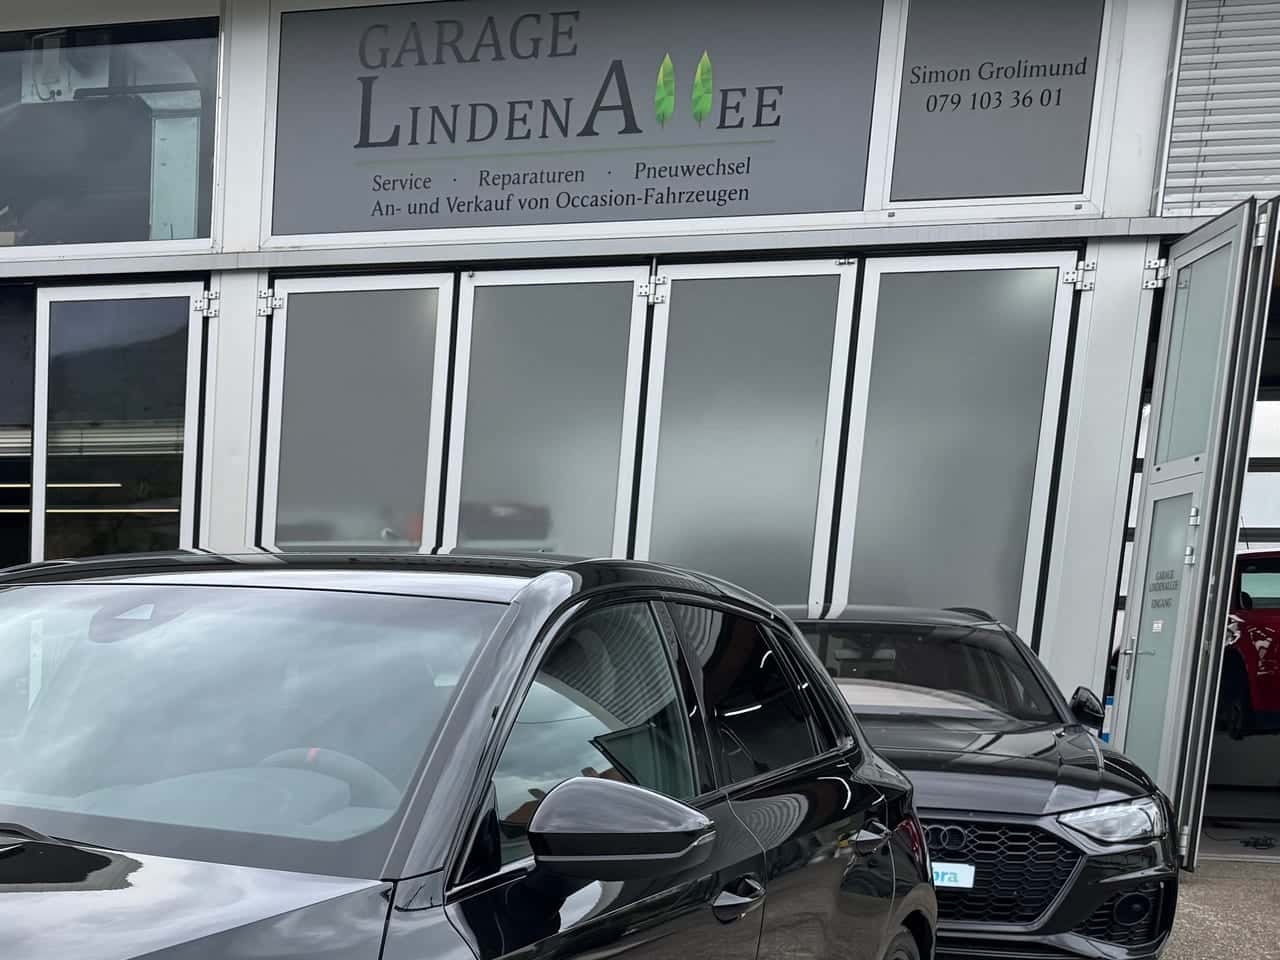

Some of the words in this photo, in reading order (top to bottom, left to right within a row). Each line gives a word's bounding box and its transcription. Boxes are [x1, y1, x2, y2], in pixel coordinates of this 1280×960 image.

[358, 10, 581, 70] GARAGE
[910, 65, 970, 84] Simon
[978, 56, 1087, 81] Grolimund
[926, 93, 961, 112] 079
[970, 91, 1002, 110] 103
[1010, 89, 1033, 108] 36
[1040, 88, 1062, 107] 01
[372, 174, 432, 192] Service
[478, 167, 586, 191] Reparaturen
[634, 157, 751, 180] Pneuwechsel
[371, 201, 401, 217] An-
[407, 198, 440, 215] und
[446, 194, 513, 214] Verkauf
[518, 198, 549, 211] von
[555, 185, 750, 209] Occasion-Fahrzeugen
